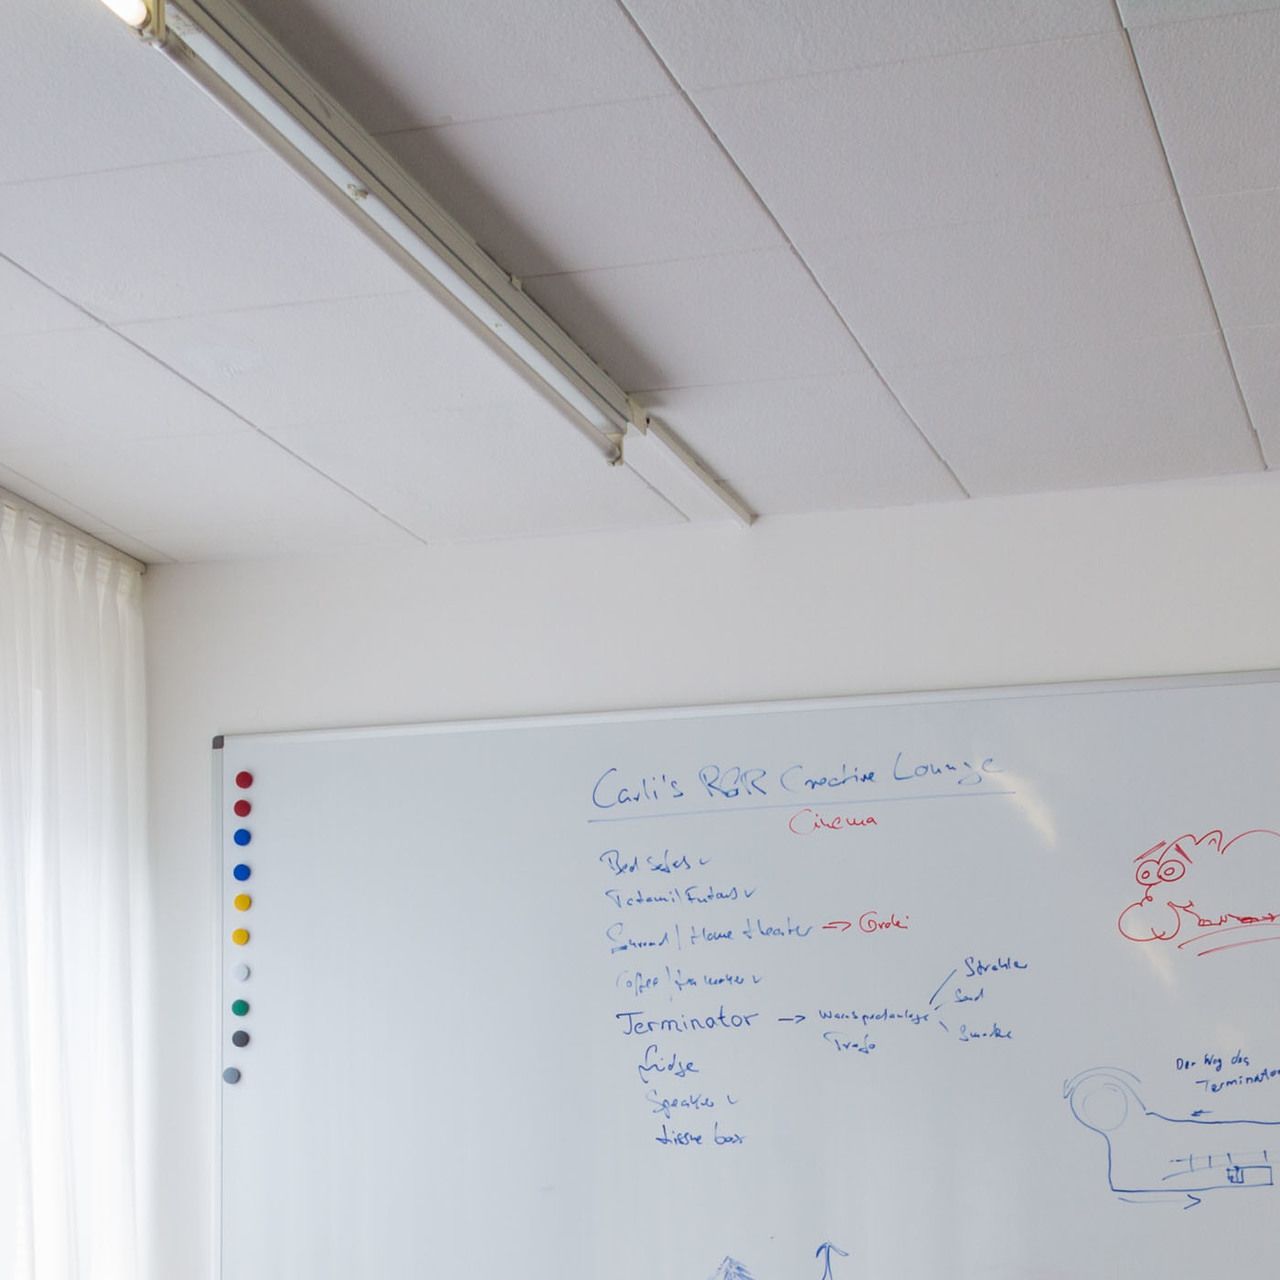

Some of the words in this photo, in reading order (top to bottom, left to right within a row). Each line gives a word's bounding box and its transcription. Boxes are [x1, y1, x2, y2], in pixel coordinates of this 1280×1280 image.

[789, 808, 877, 835] Cinema
[616, 1005, 759, 1035] Terminator
[1176, 1057, 1196, 1071] Der
[1204, 1053, 1222, 1072] Weg
[1231, 1049, 1250, 1067] des
